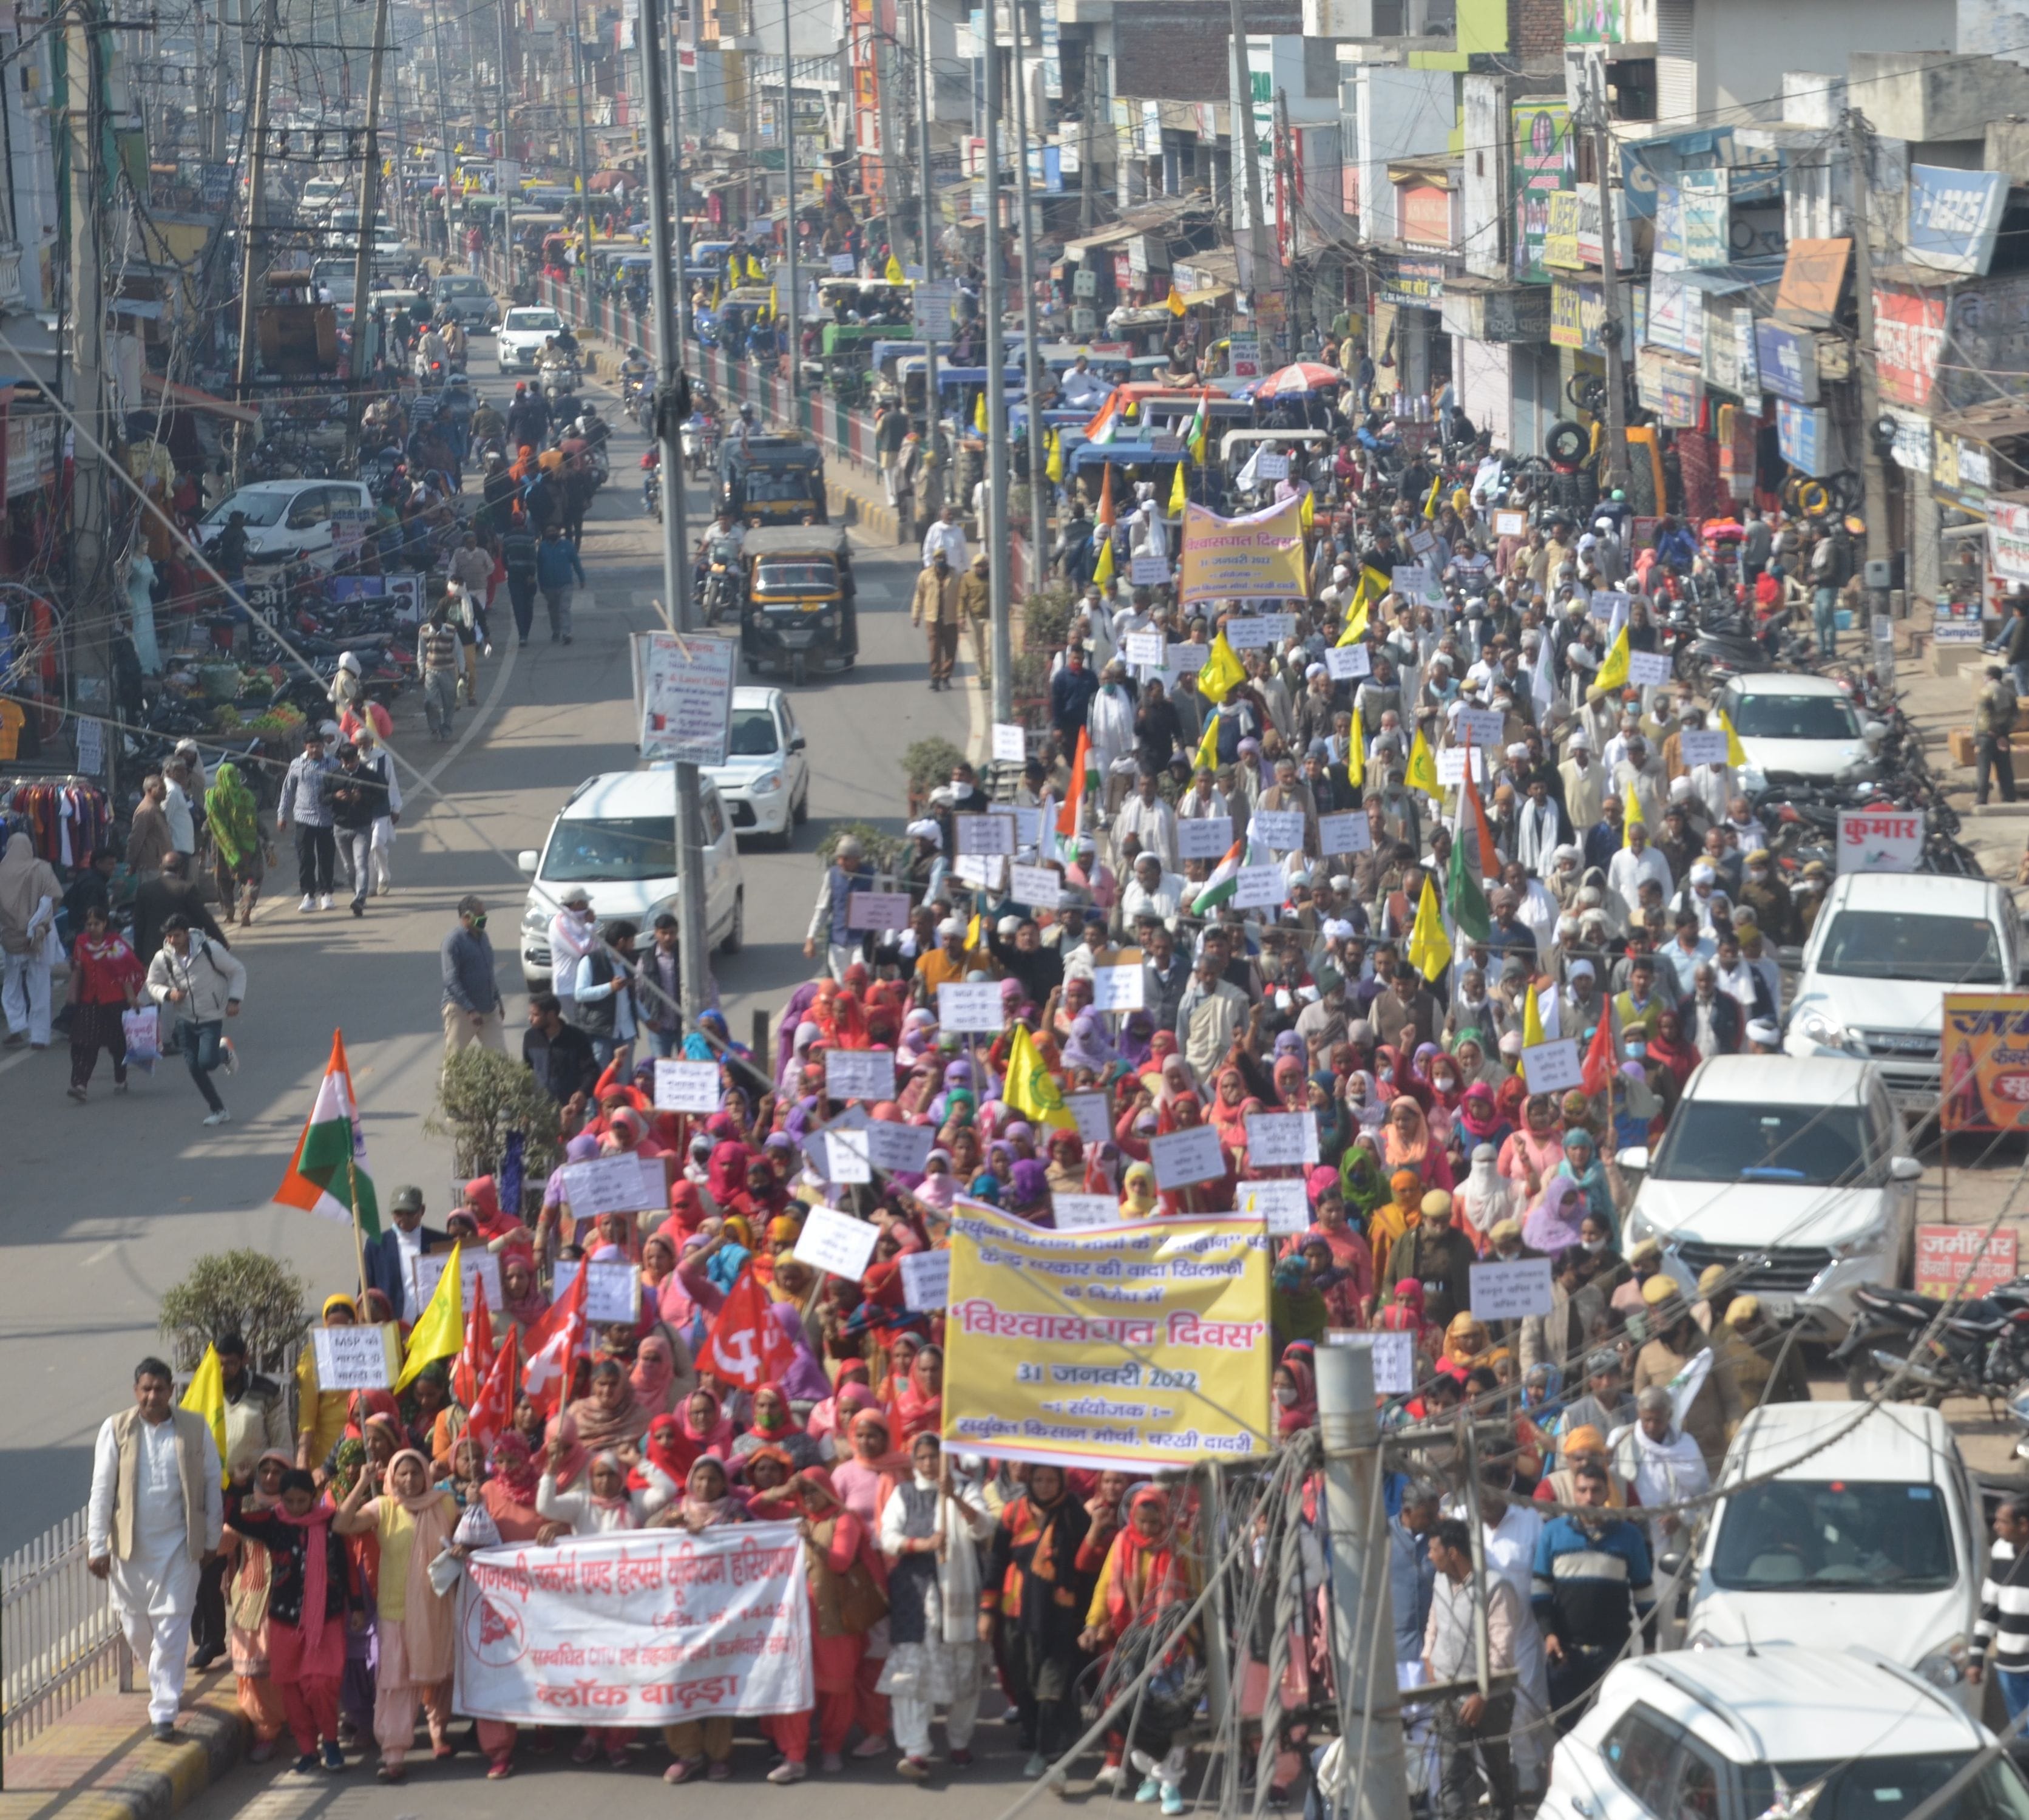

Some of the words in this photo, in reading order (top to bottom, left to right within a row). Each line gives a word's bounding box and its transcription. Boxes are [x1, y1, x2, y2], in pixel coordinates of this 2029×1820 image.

[1935, 626, 1982, 640] Campus
[1844, 817, 1918, 845] कुमार
[1096, 1258, 1120, 1275] की
[1018, 1365, 1042, 1381] 31
[1052, 1361, 1139, 1387] जनवरी
[1150, 1368, 1197, 1389] 2022
[1069, 1398, 1145, 1418] संयोजक
[1023, 1421, 1087, 1441] किसान
[1147, 1430, 1198, 1448] चरखी
[1205, 1432, 1252, 1452] दादरी
